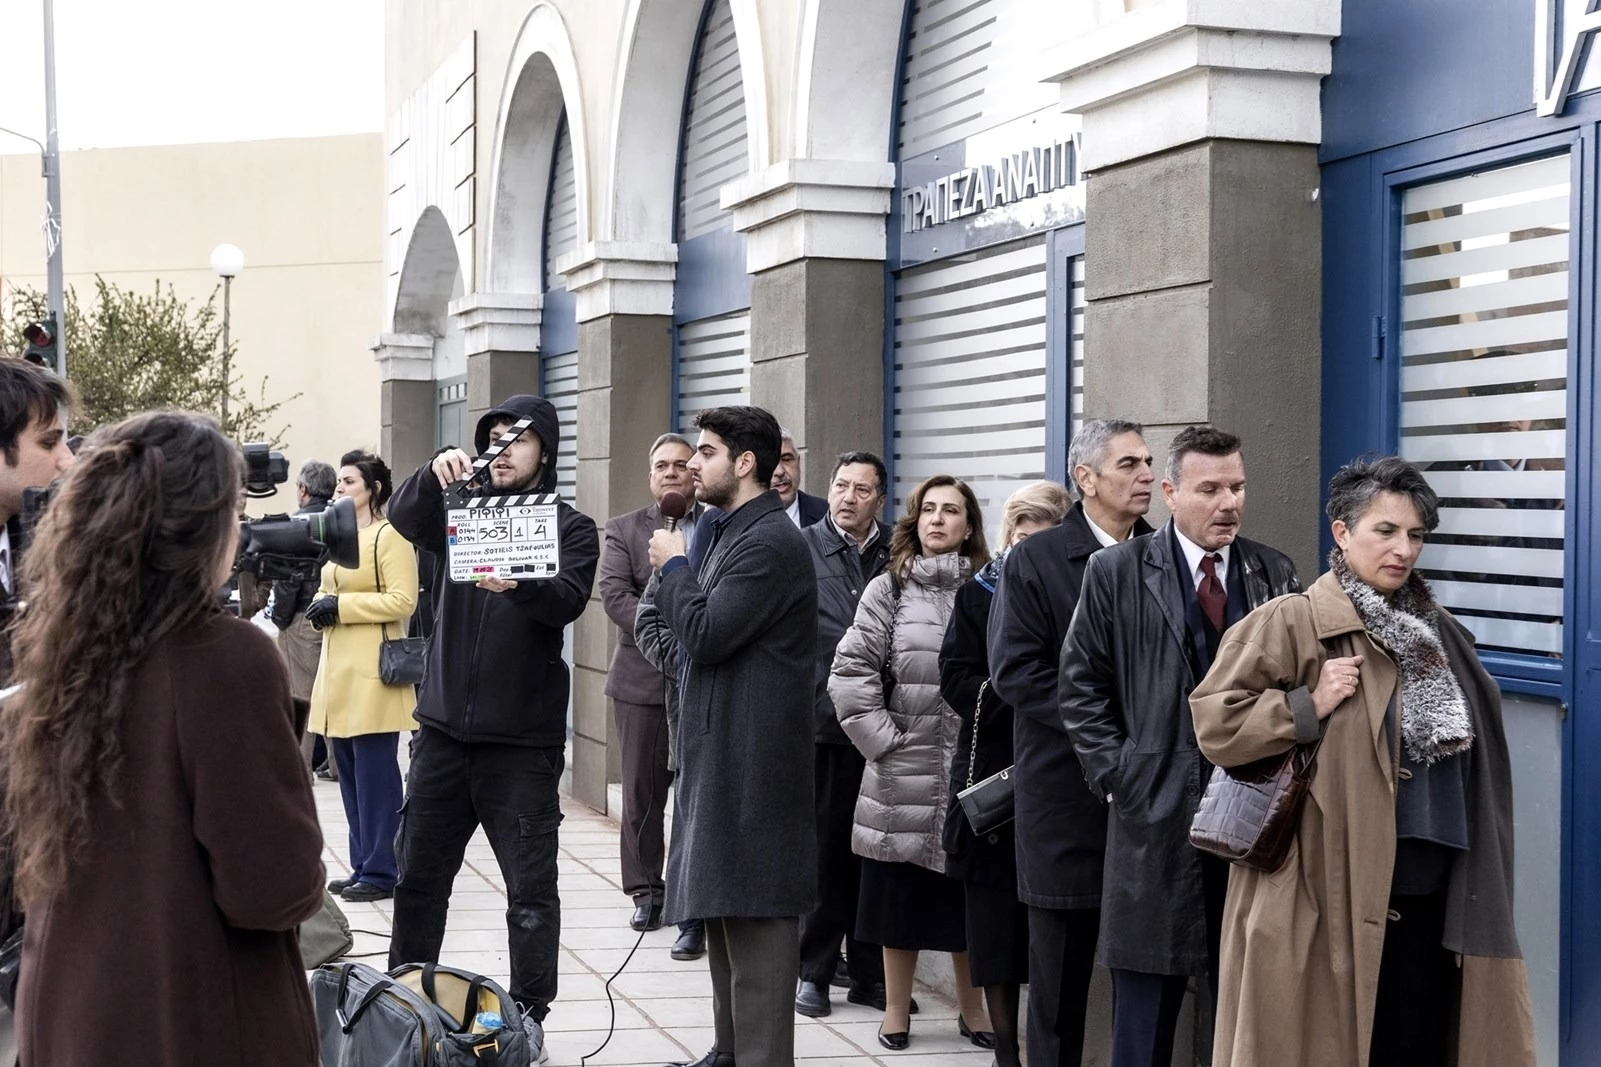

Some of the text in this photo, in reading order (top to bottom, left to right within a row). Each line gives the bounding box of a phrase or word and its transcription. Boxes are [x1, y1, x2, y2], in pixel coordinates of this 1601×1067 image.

[903, 165, 989, 233] ΤΡΑΠΕΖΑ
[479, 526, 509, 541] 503
[514, 526, 524, 538] 1
[534, 524, 547, 539] 4
[484, 545, 513, 555] SOTIRIS
